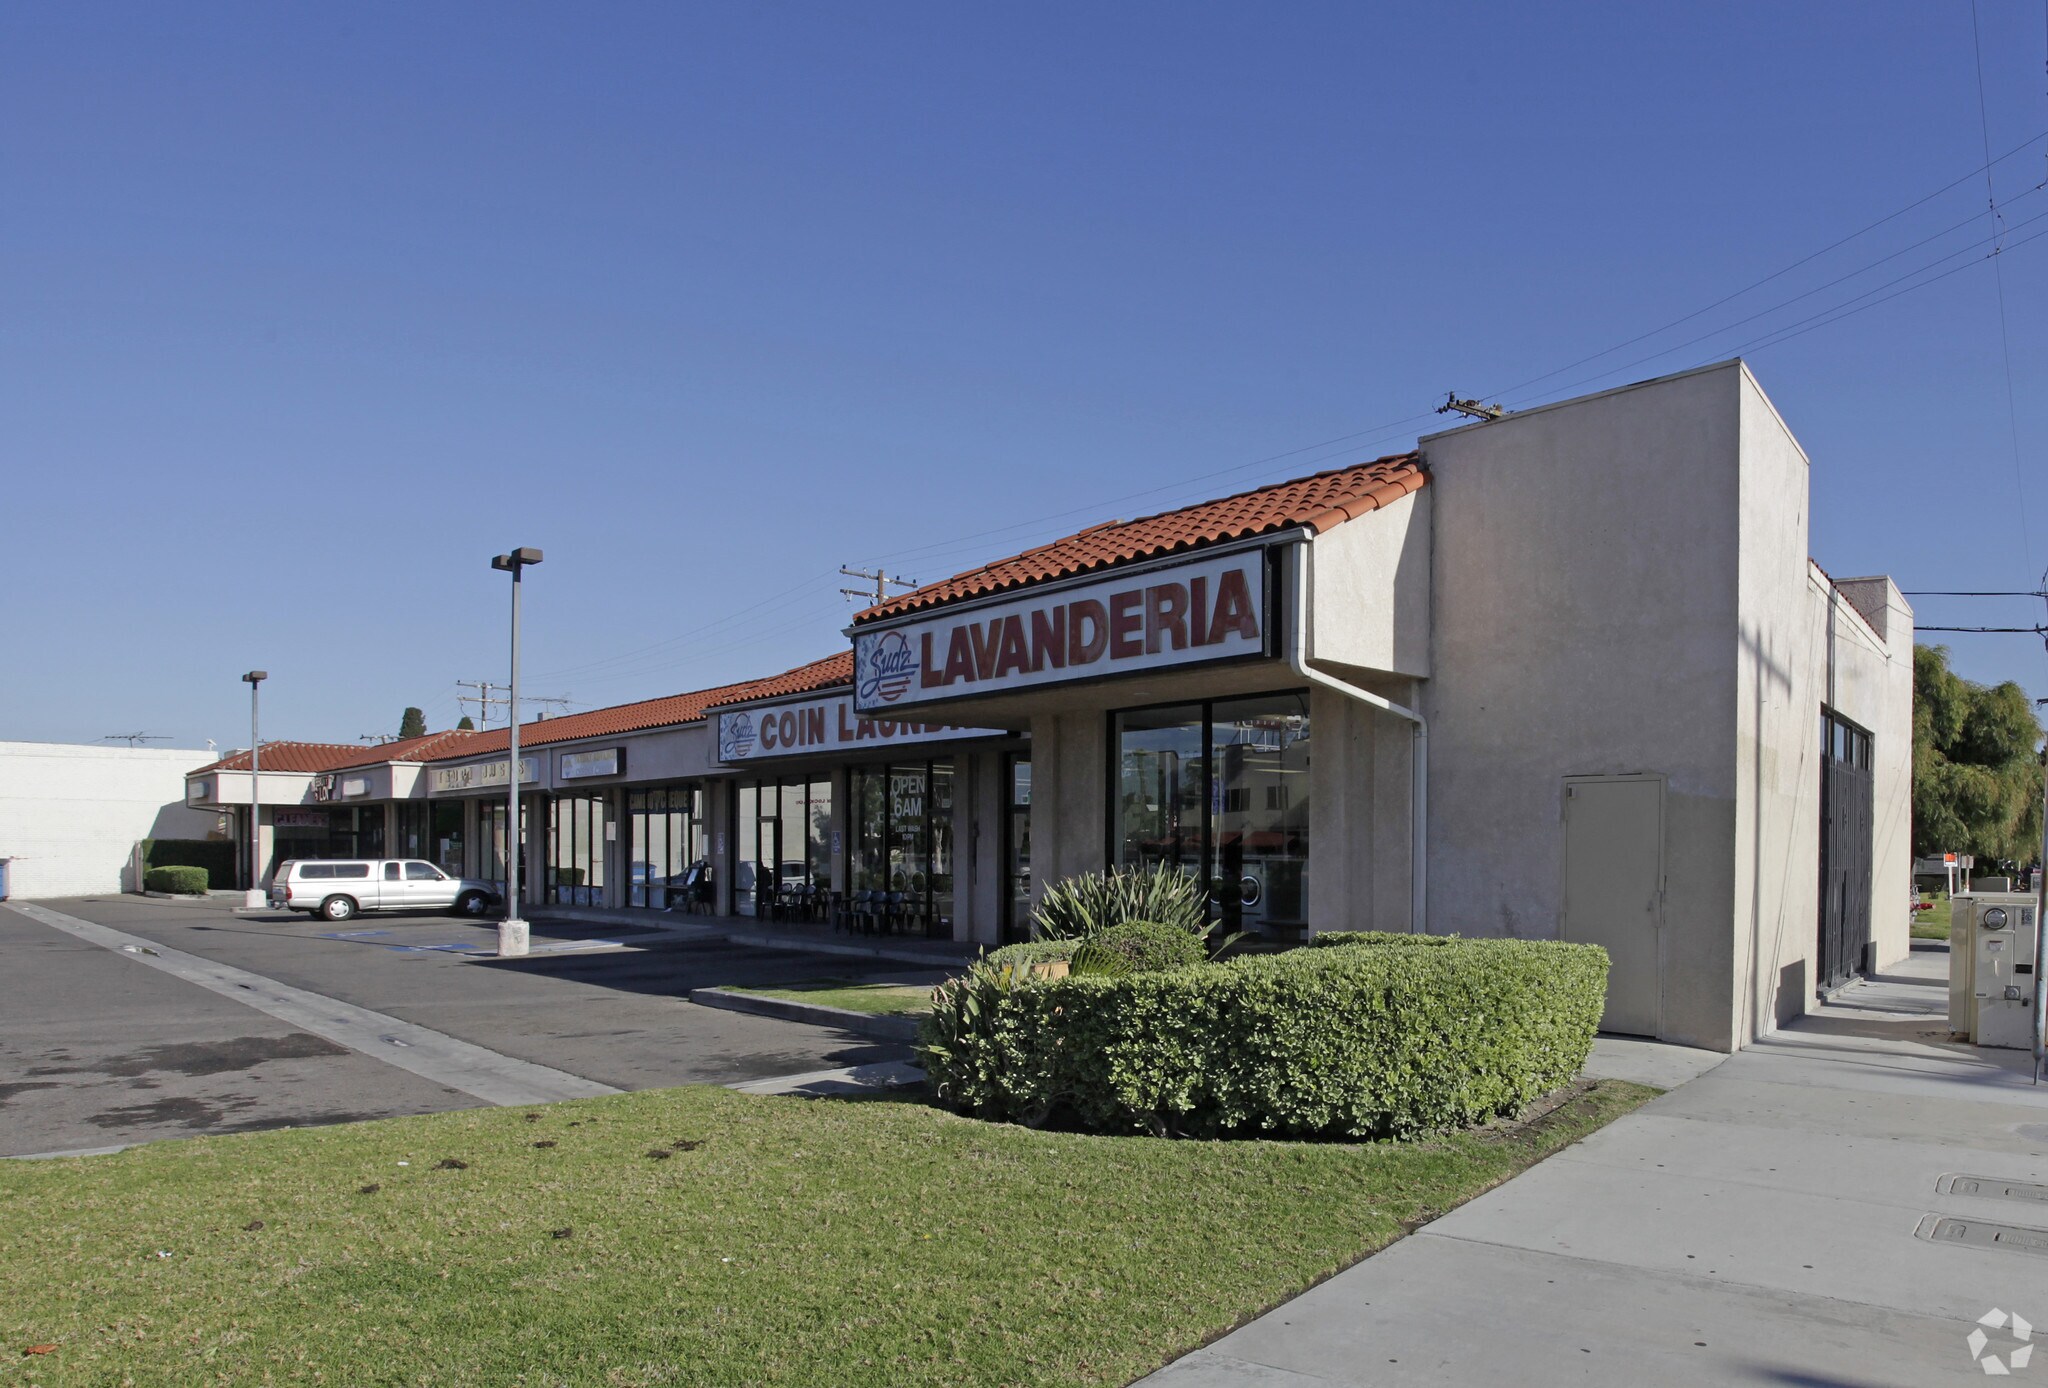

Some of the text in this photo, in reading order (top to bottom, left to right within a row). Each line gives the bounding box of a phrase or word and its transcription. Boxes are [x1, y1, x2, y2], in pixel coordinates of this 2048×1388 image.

[920, 568, 1260, 689] LAVANDERIA
[861, 634, 919, 699] Sudz
[760, 706, 825, 750] COIN
[891, 774, 926, 795] OPEN
[894, 797, 922, 818] 6AM
